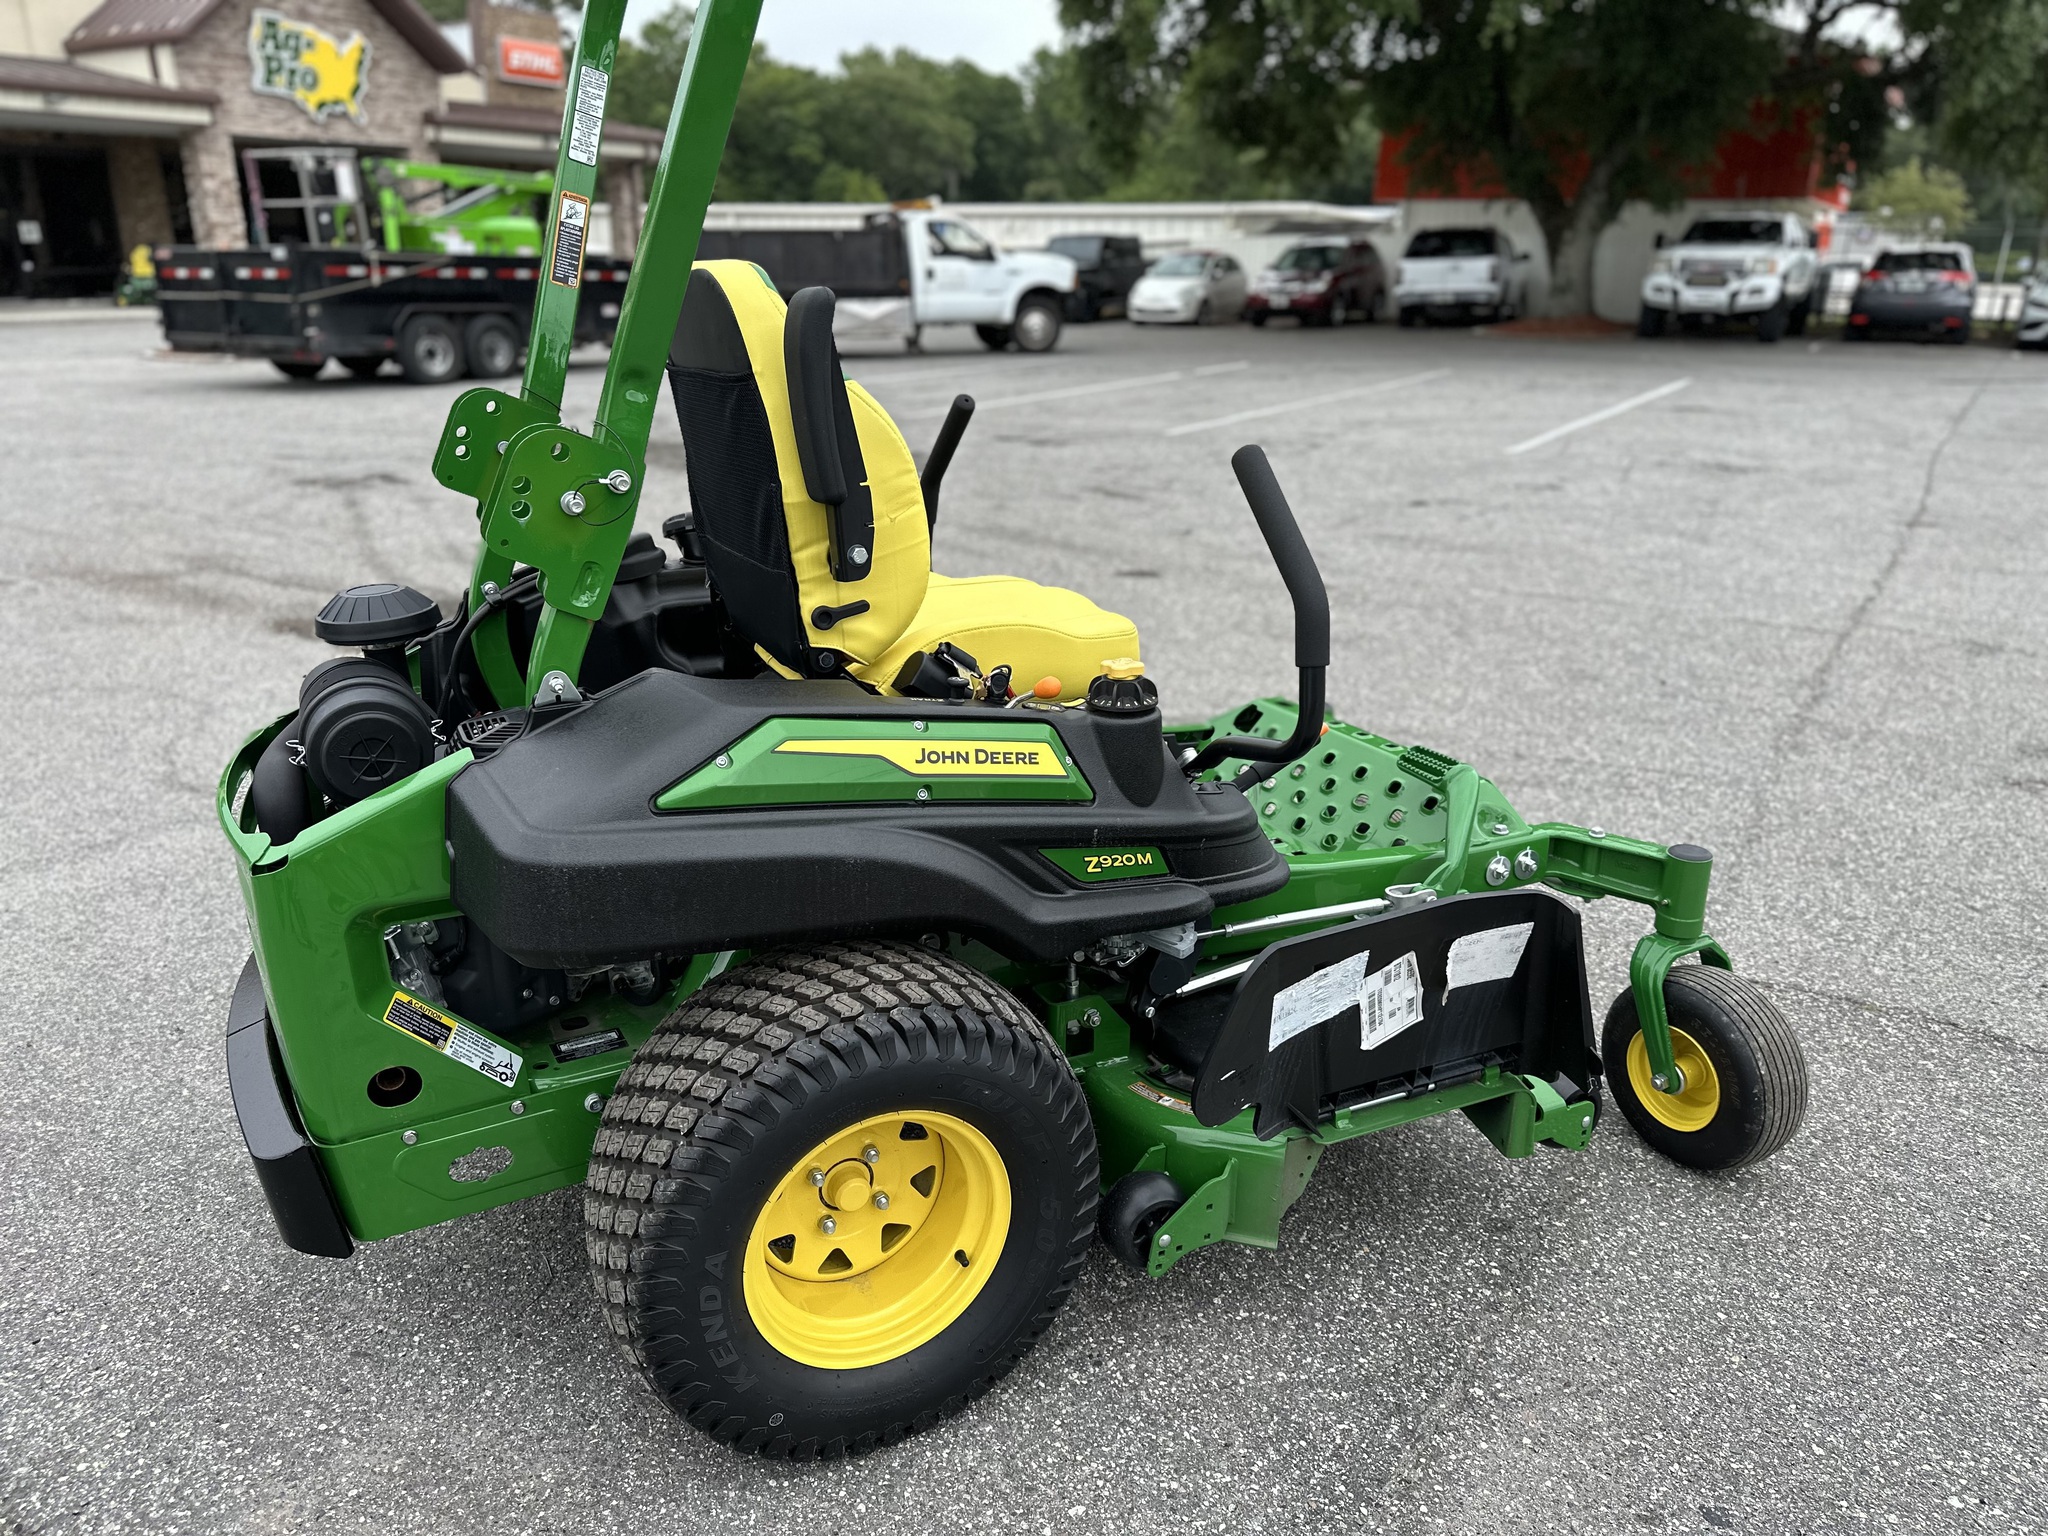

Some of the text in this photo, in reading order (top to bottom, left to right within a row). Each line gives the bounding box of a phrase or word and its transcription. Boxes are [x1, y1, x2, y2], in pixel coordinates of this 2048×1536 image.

[264, 56, 319, 90] Pro
[508, 50, 559, 75] STIHL
[914, 748, 1040, 766] JOHN DEERE
[1084, 852, 1154, 874] Z920M
[413, 1001, 444, 1021] CAUTION
[959, 1078, 1051, 1153] TURF
[699, 1250, 761, 1394] KENDA
